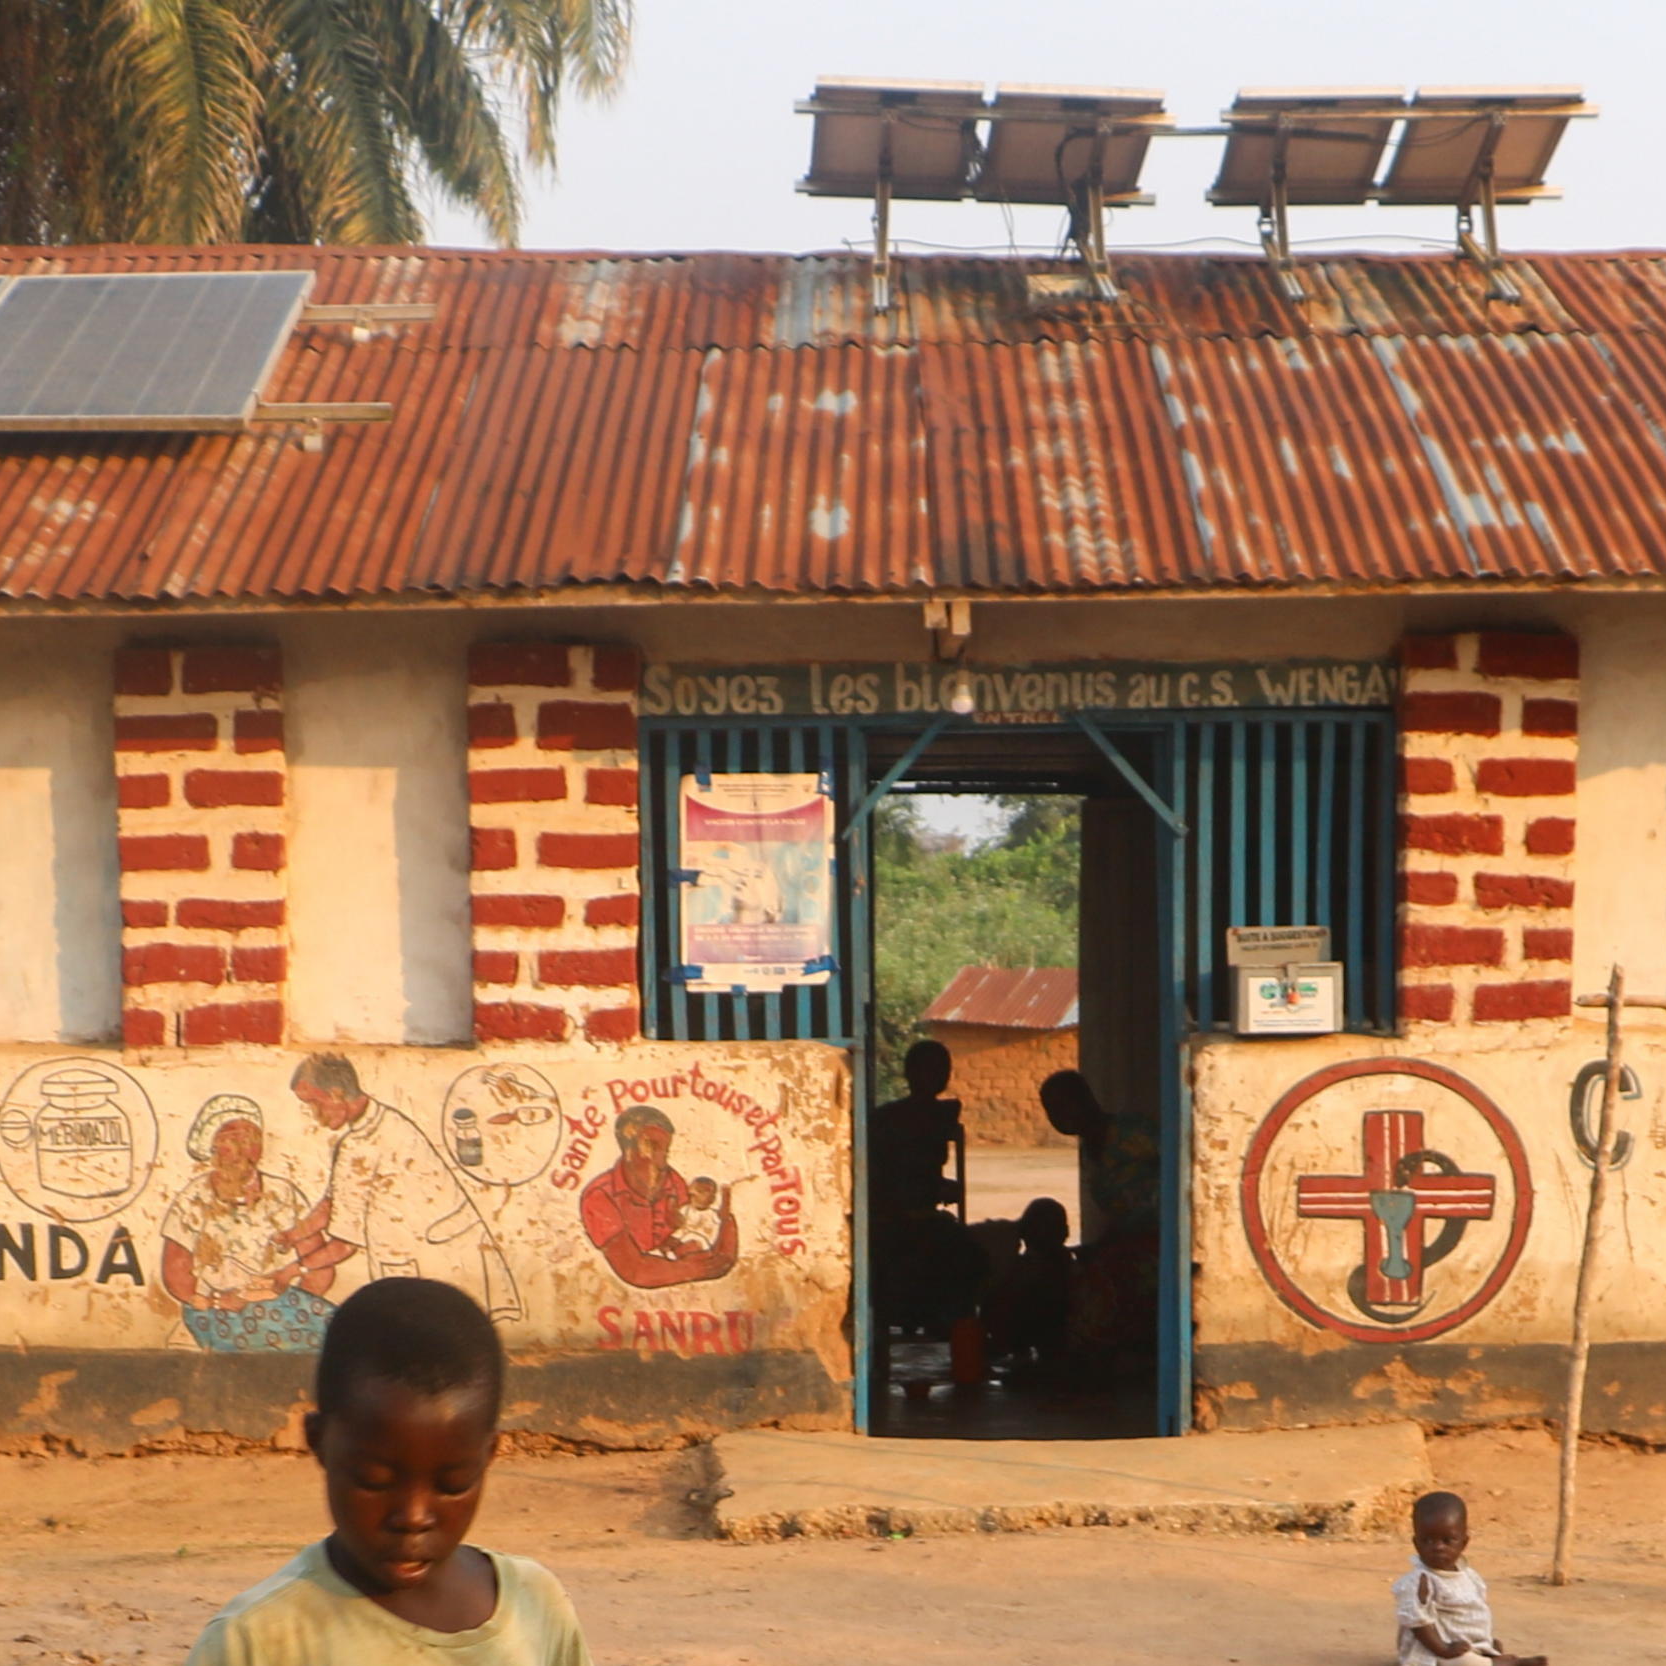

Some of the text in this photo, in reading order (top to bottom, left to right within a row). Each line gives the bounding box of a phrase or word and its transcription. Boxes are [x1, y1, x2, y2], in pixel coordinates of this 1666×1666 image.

[642, 663, 784, 716] Soyez
[810, 662, 880, 716] les
[1128, 672, 1171, 709] au
[595, 1304, 756, 1356] SANRU
